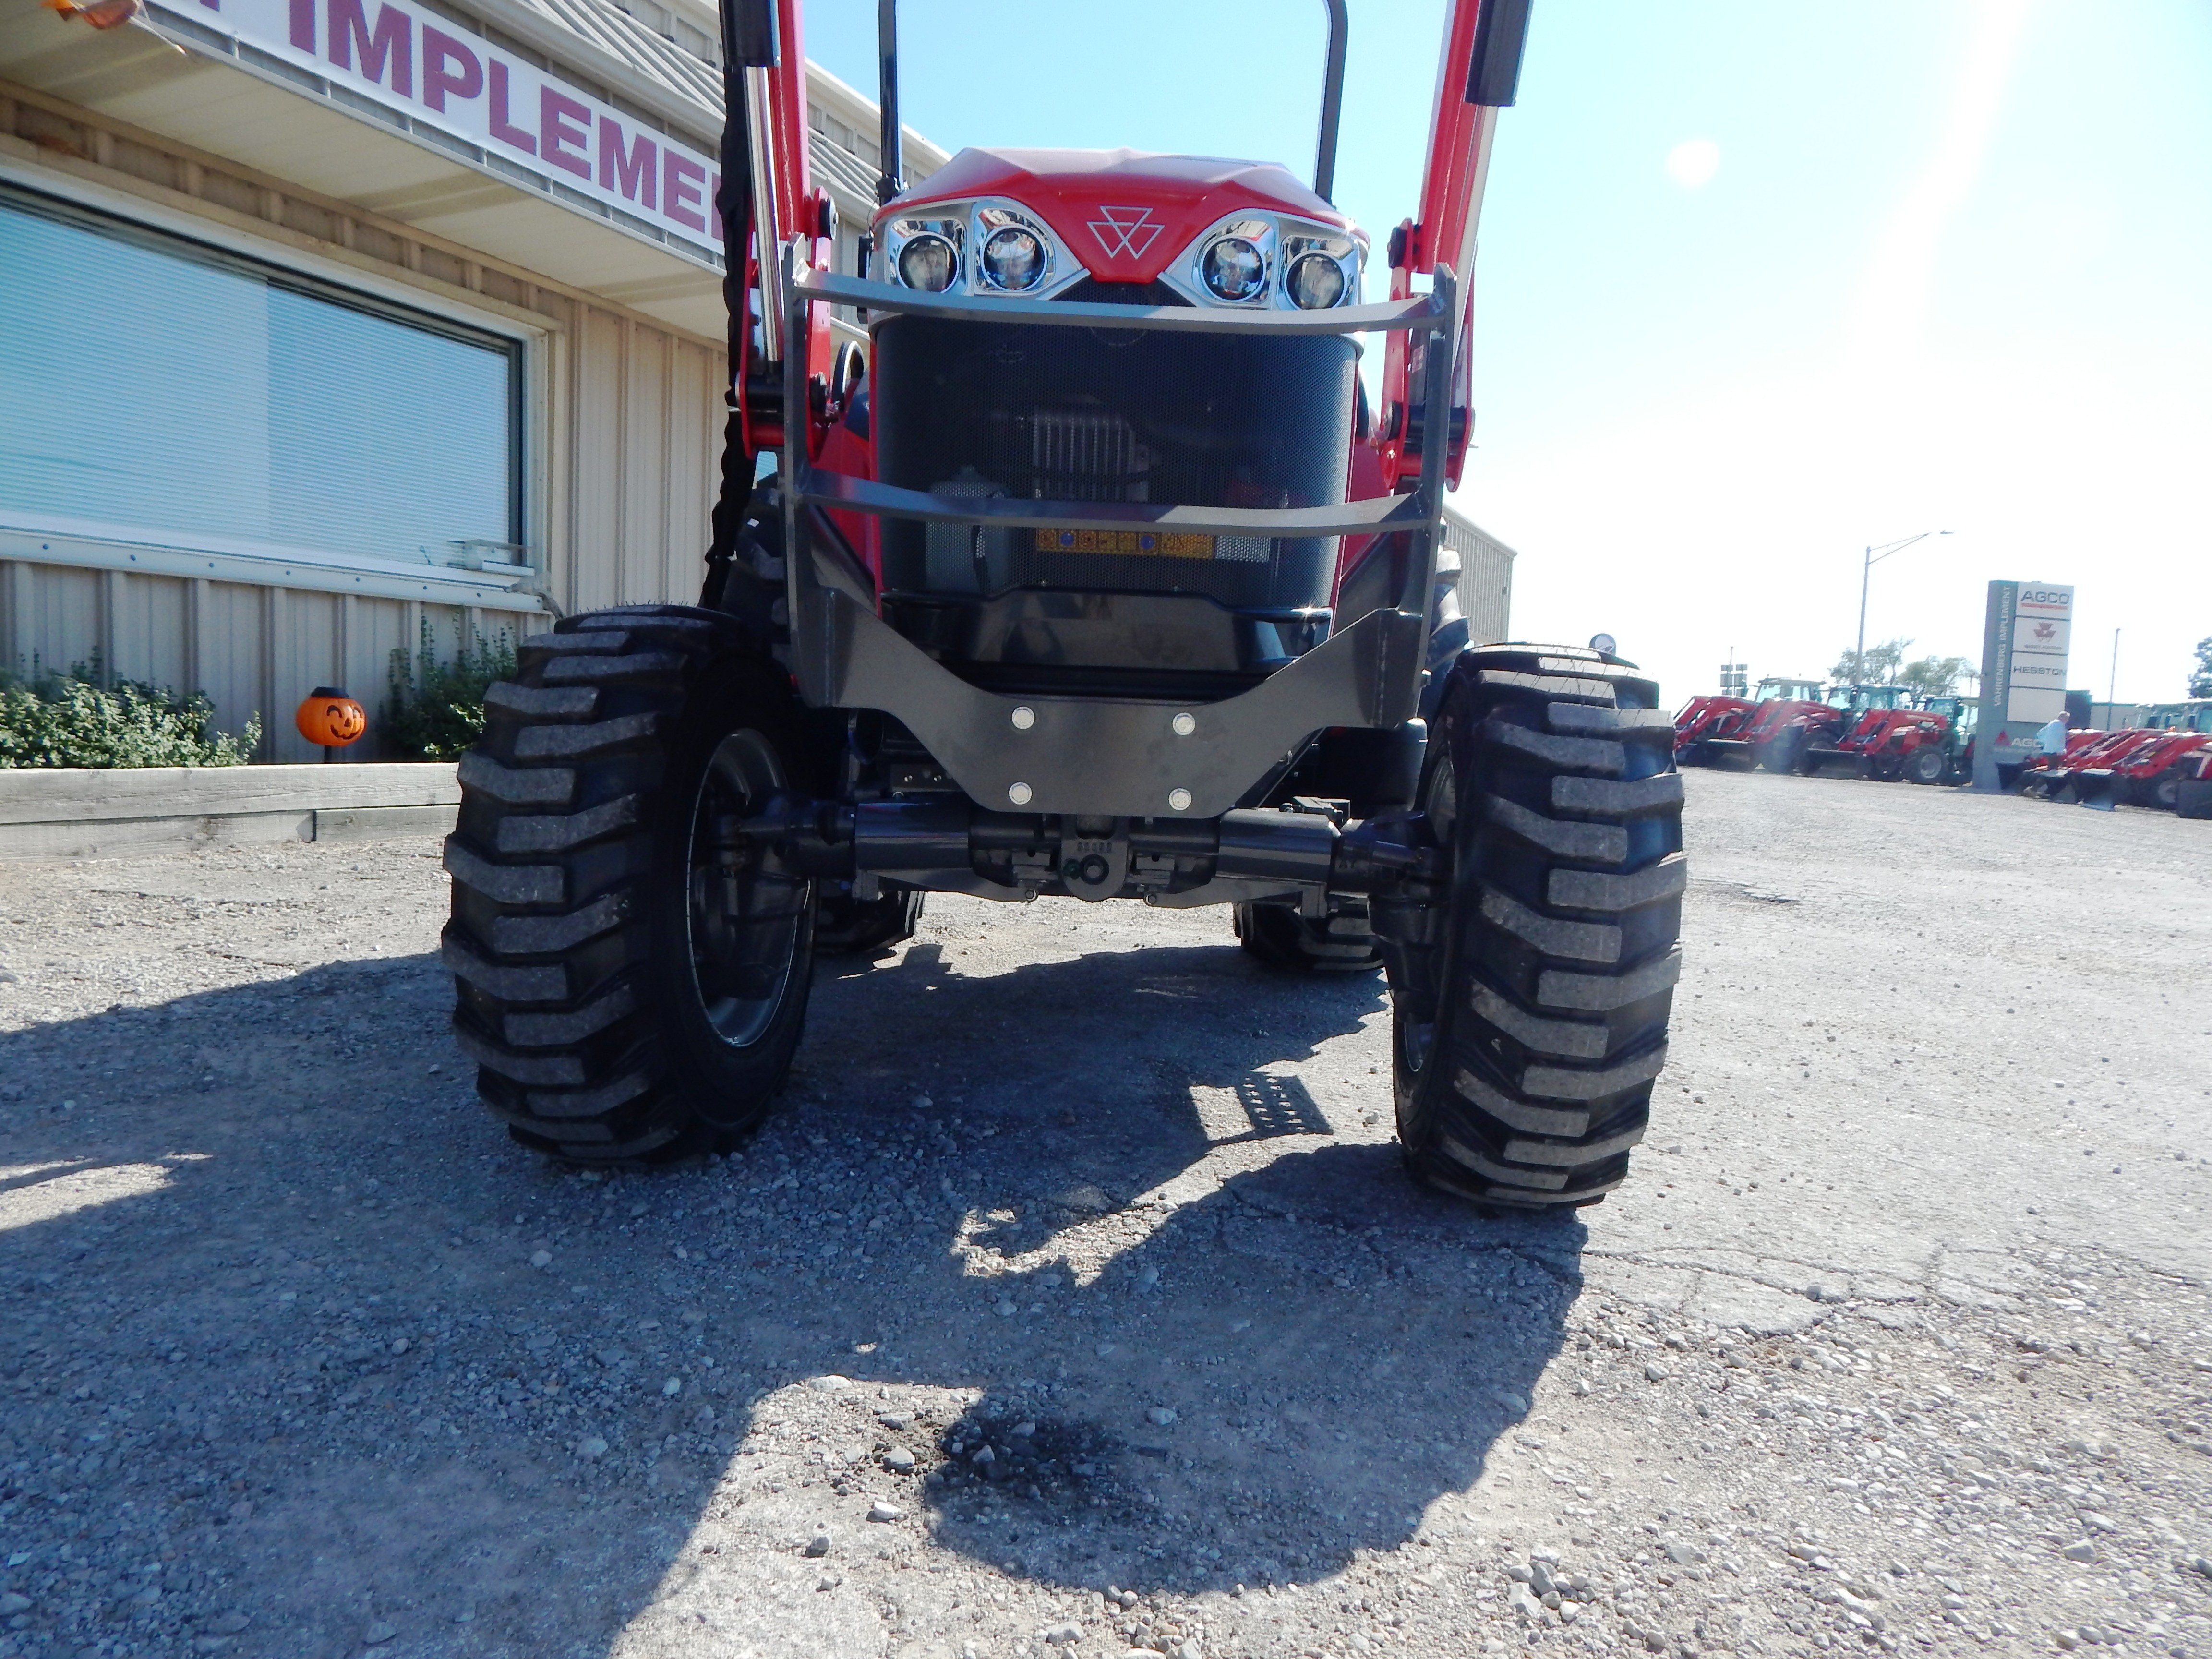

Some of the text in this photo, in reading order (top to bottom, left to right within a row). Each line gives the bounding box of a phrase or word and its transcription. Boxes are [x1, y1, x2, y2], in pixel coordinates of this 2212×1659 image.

[288, 0, 724, 242] IMPLEME
[2020, 591, 2069, 604] AGCO
[1994, 585, 2010, 706] VAHRENBERG IMPLEMENT
[2013, 666, 2066, 676] HESSTON
[2011, 738, 2044, 748] AGC
